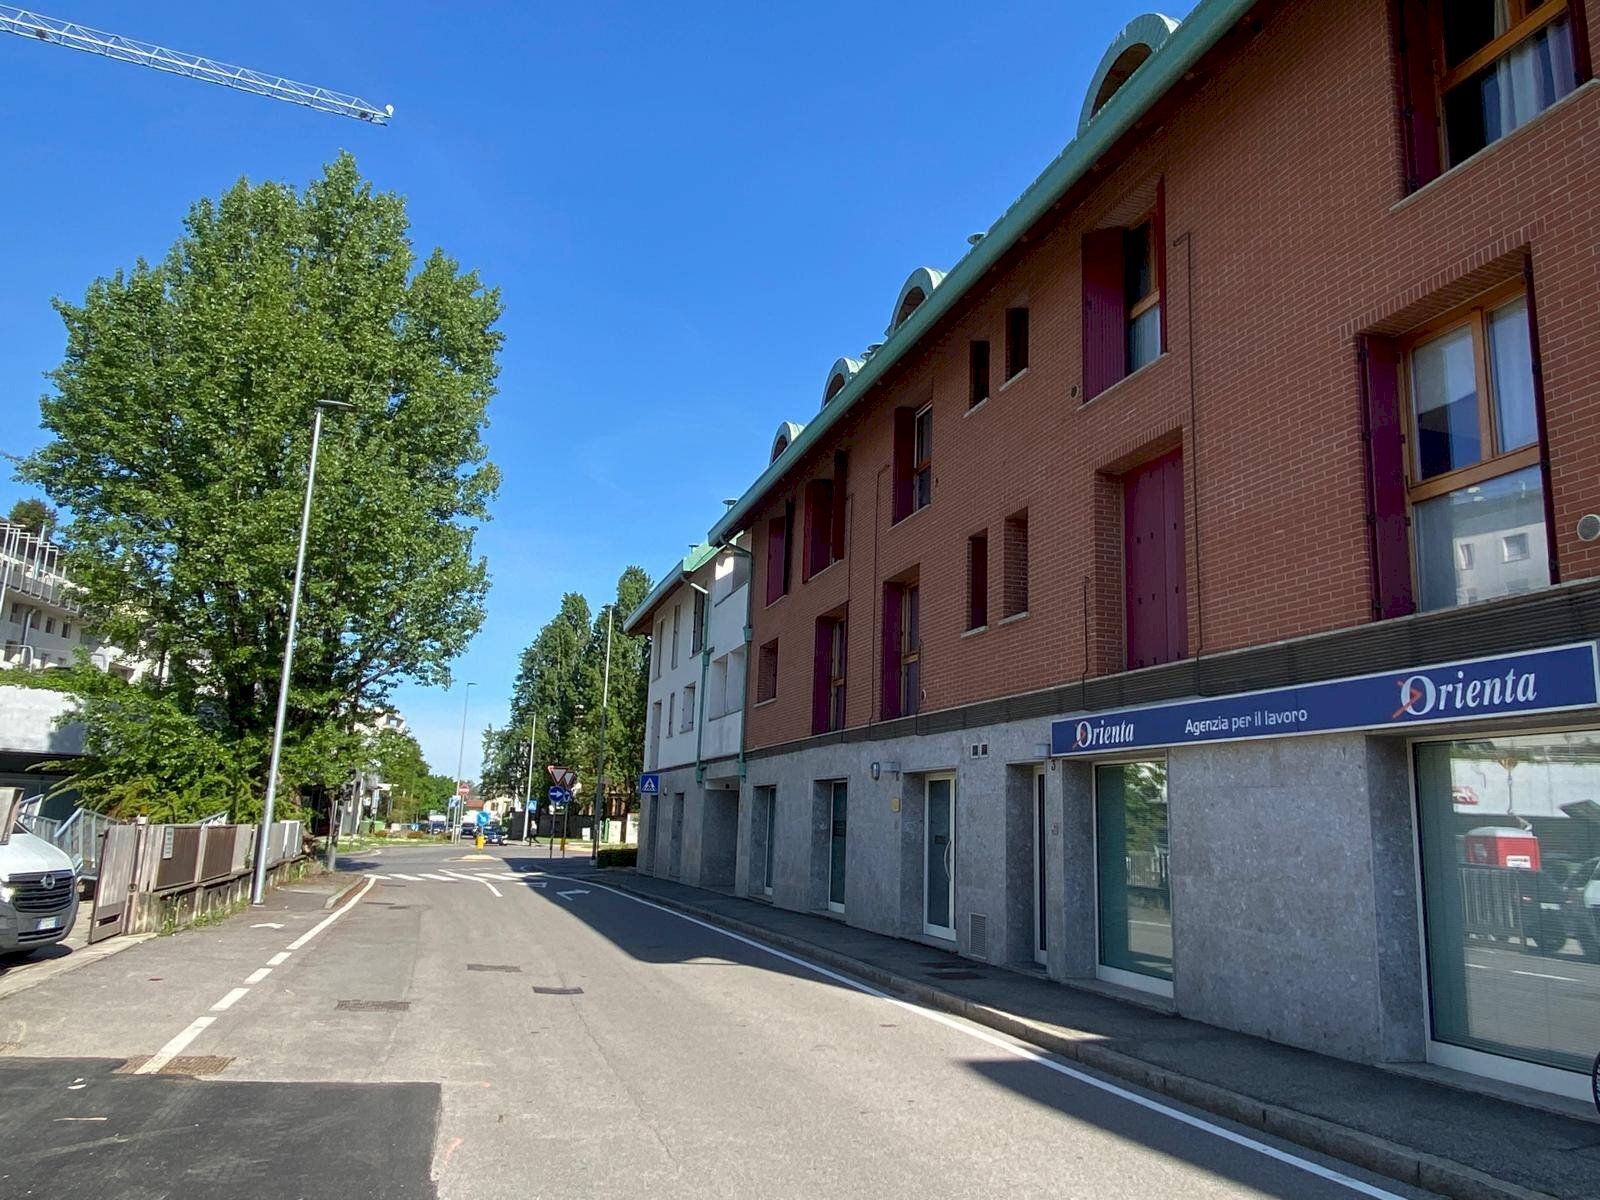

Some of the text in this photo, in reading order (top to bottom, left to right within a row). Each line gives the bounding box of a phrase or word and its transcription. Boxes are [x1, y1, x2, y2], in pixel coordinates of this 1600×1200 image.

[1400, 668, 1537, 716] Orienta
[1075, 719, 1134, 748] Orienta
[1184, 716, 1229, 735] Agenzia
[1232, 715, 1252, 732] per
[1265, 709, 1308, 725] lavoro
